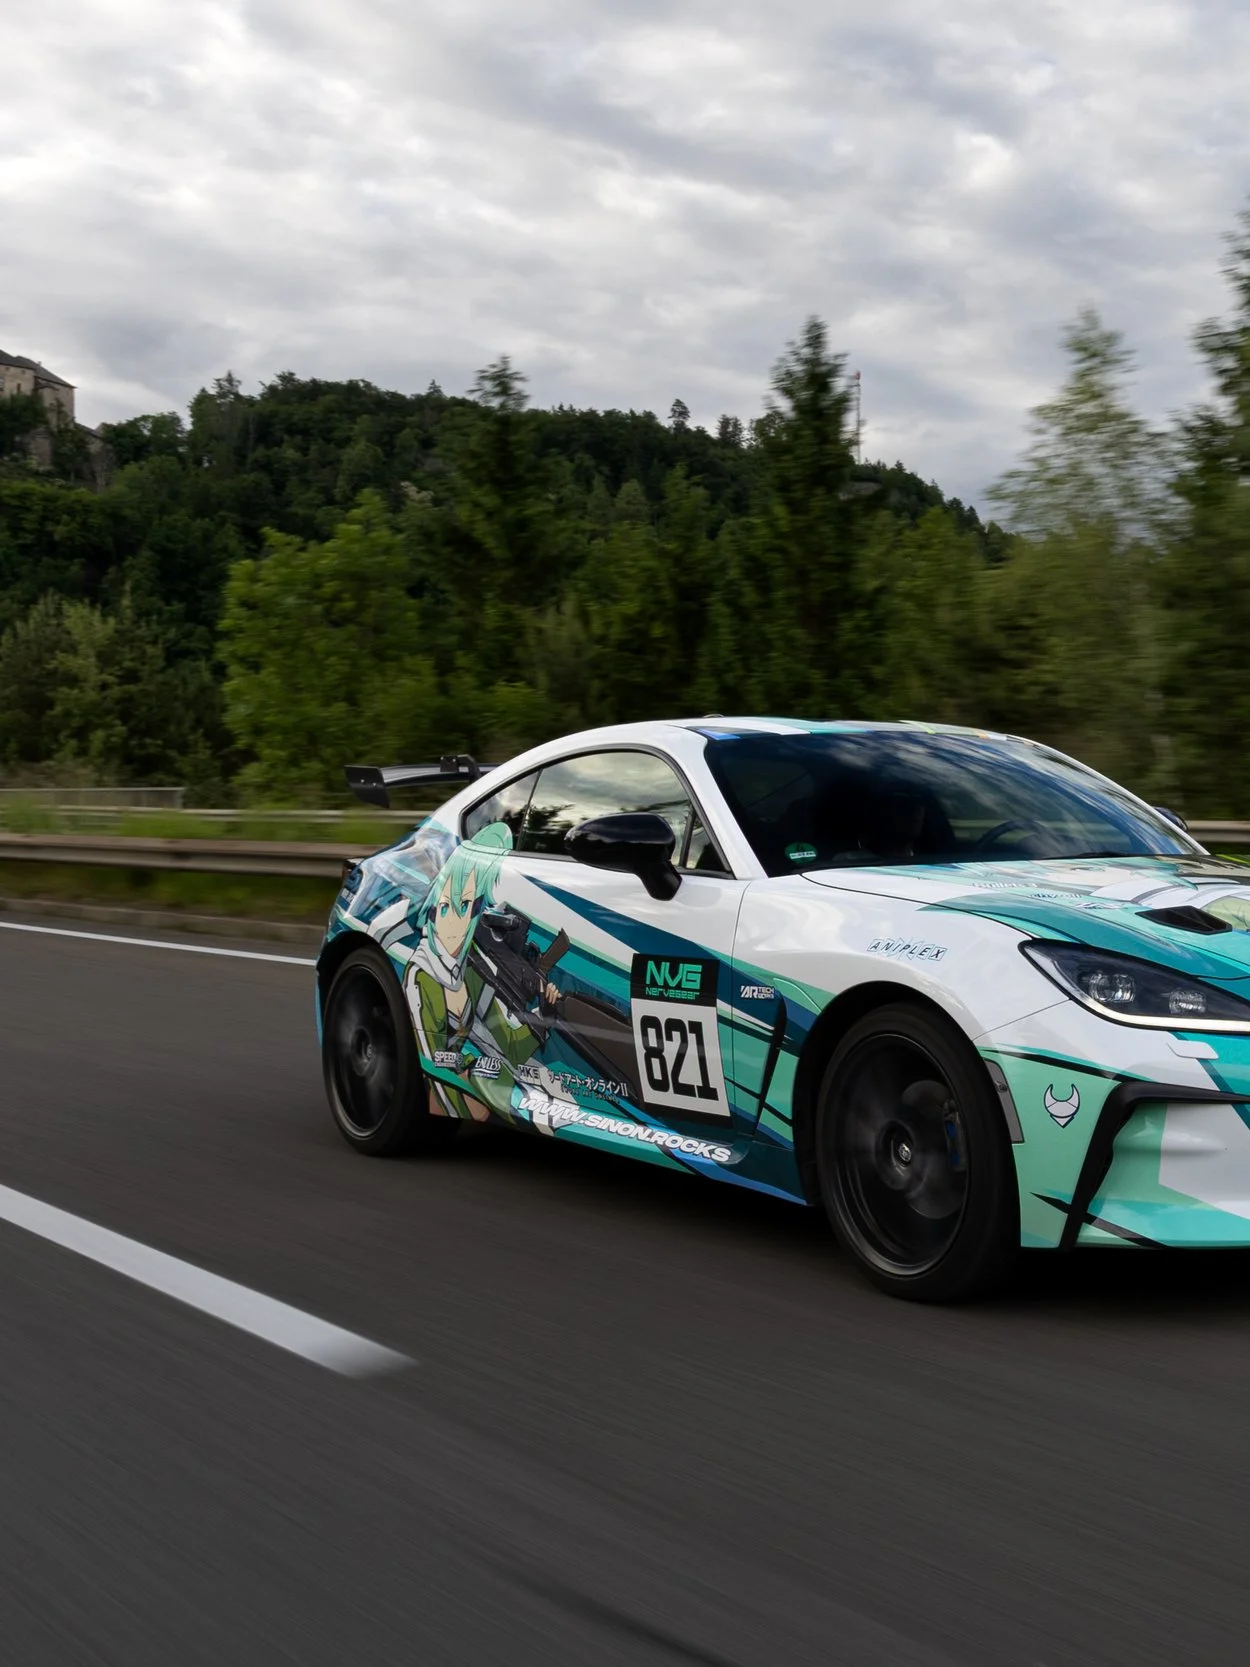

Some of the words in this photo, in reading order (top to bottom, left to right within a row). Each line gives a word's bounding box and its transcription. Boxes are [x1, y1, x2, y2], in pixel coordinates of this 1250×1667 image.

[868, 939, 946, 960] ANIPLEX
[646, 961, 702, 989] NVG
[434, 1051, 457, 1063] SPEED
[475, 1055, 501, 1071] ENDLESS
[640, 1015, 719, 1101] 821
[519, 1065, 540, 1079] HKS
[518, 1097, 732, 1162] WWW.SINON.ROCKS
